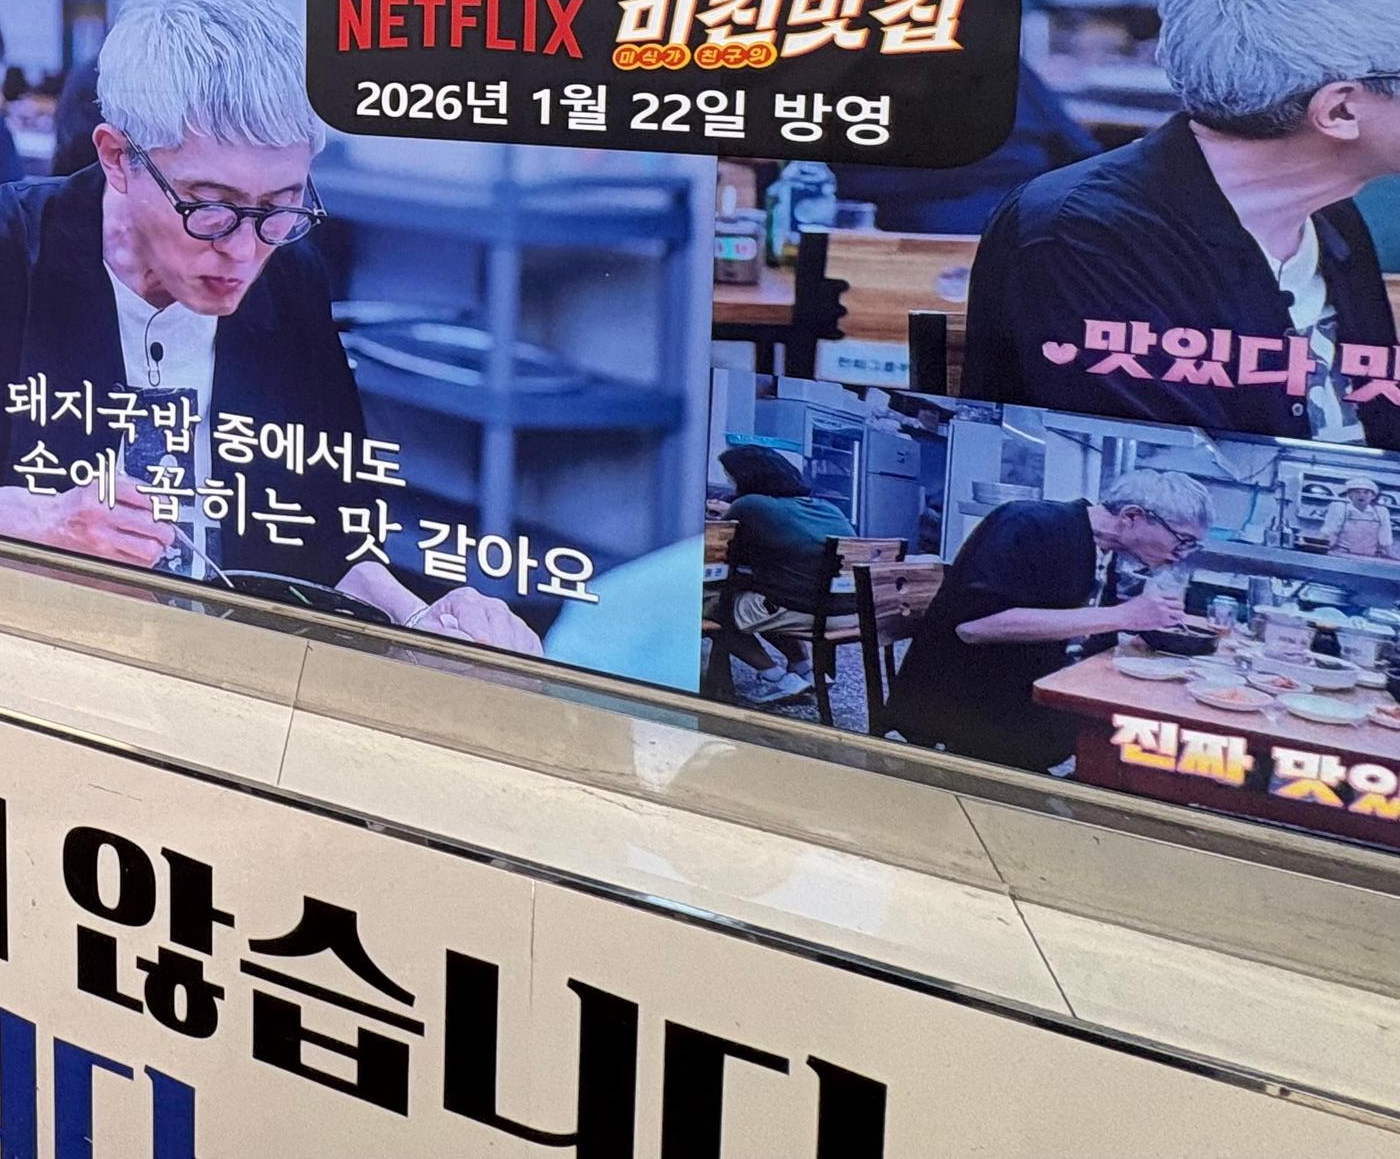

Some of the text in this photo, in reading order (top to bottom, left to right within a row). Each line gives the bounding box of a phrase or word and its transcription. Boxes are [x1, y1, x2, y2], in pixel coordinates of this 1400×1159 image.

[617, 45, 773, 70] 미식가 친구의
[356, 80, 892, 147] 2026년 1월 22일 방영
[1084, 318, 1317, 397] 맛있다
[6, 380, 200, 451] 돼지국밥
[212, 411, 407, 488] 중에서도
[13, 443, 600, 604] 손에 꼽히는 맛 같아요
[1113, 712, 1255, 786] 진짜
